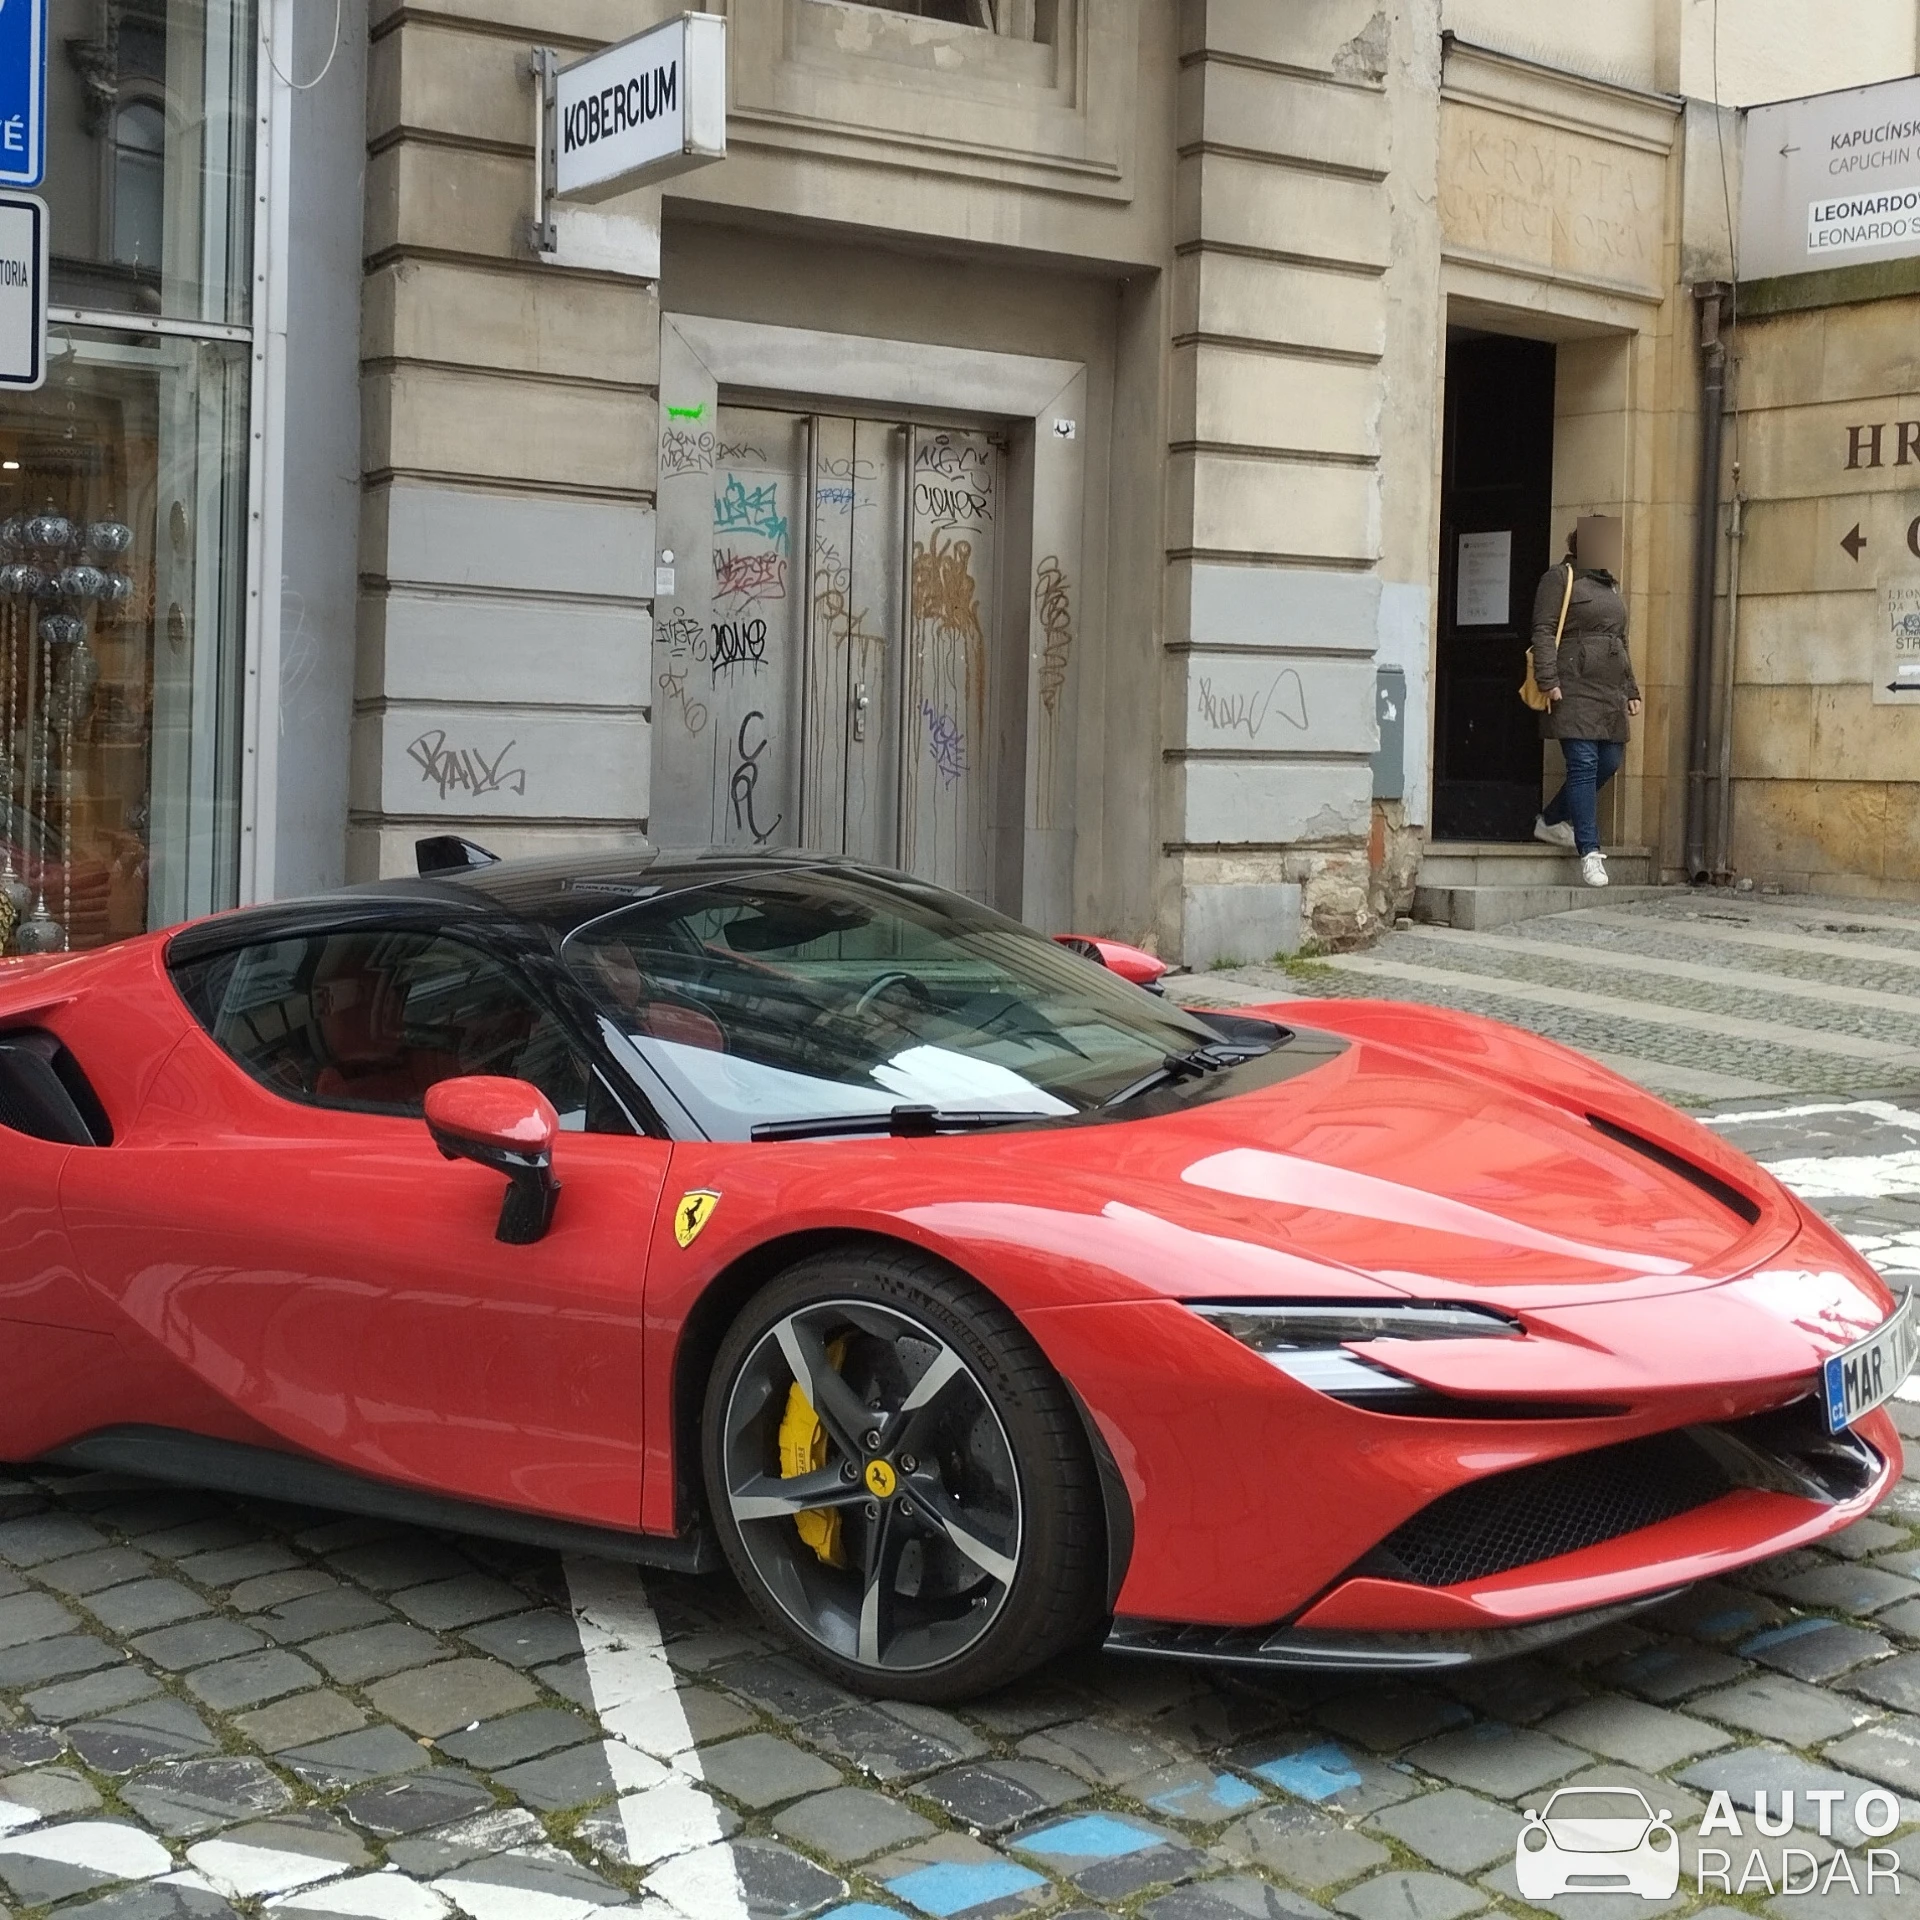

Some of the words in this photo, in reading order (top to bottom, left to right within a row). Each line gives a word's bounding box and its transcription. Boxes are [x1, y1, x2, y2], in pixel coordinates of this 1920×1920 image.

[564, 60, 677, 154] KOBERCIUM
[1828, 146, 1910, 176] CAPUCHIN
[1814, 191, 1920, 222] LEONARDO
[1844, 1345, 1883, 1415] MAR
[1832, 1401, 1844, 1422] CZ
